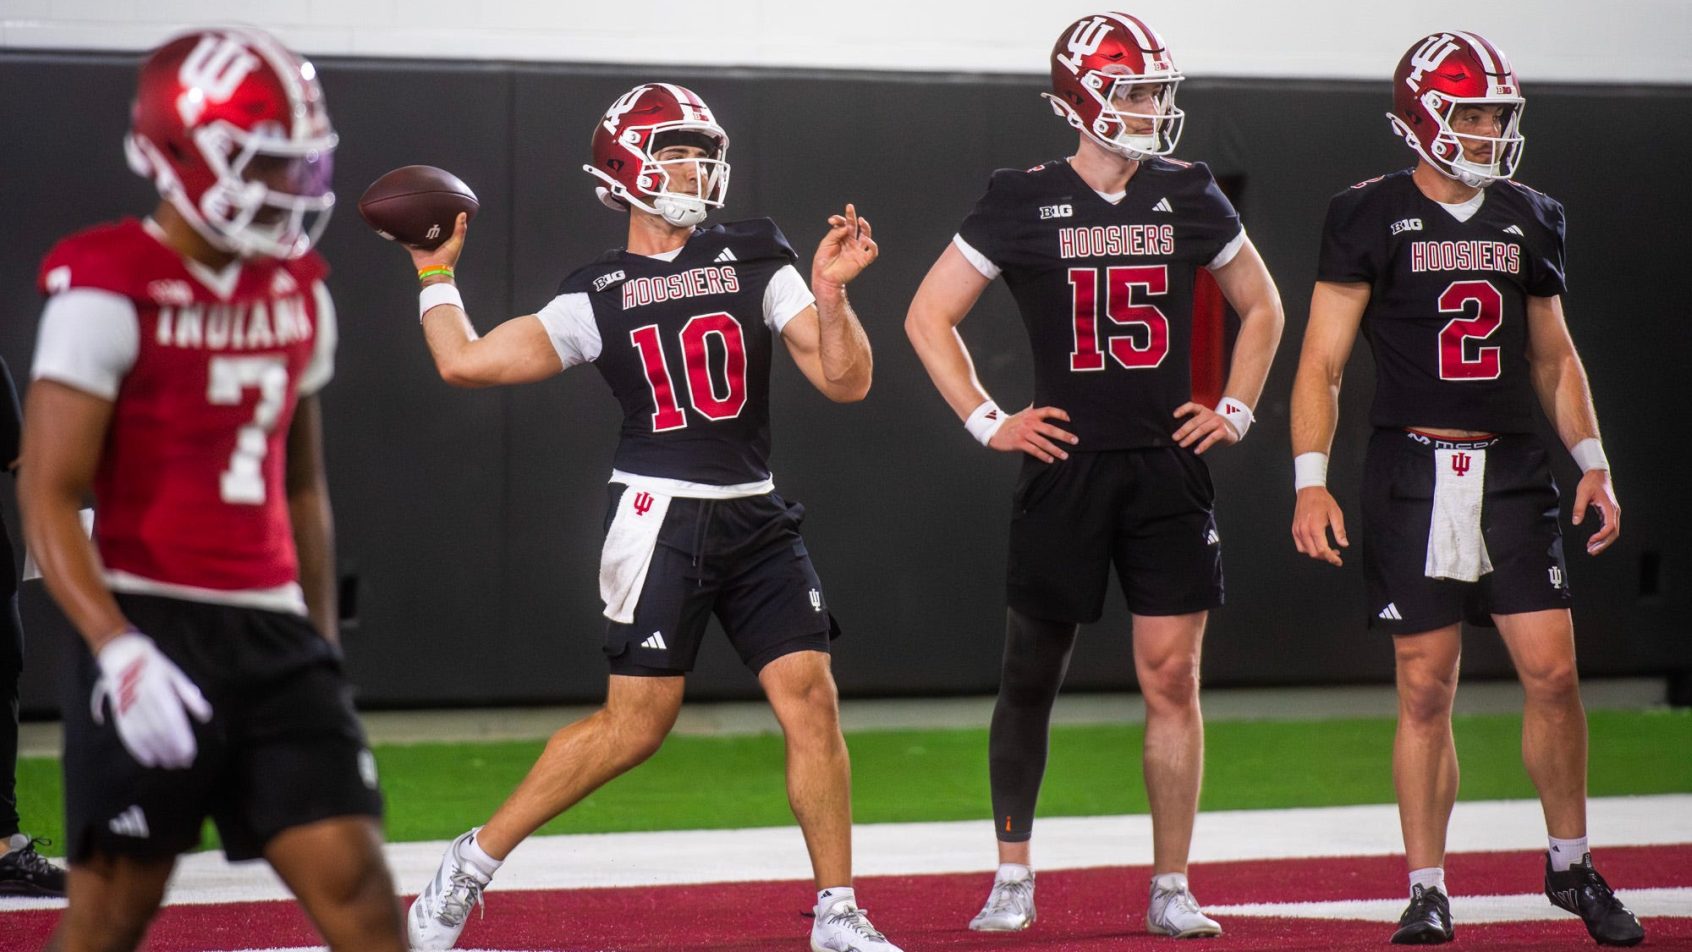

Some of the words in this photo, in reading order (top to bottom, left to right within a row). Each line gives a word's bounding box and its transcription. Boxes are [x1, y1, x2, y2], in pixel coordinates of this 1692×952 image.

[622, 266, 740, 310] HOOSIERS
[1059, 224, 1175, 258] HOOSIERS
[1411, 240, 1521, 274] HOOSIERS
[1067, 264, 1169, 372] 15
[1437, 280, 1503, 381] 2
[629, 311, 748, 433] 10
[206, 355, 288, 505] 7
